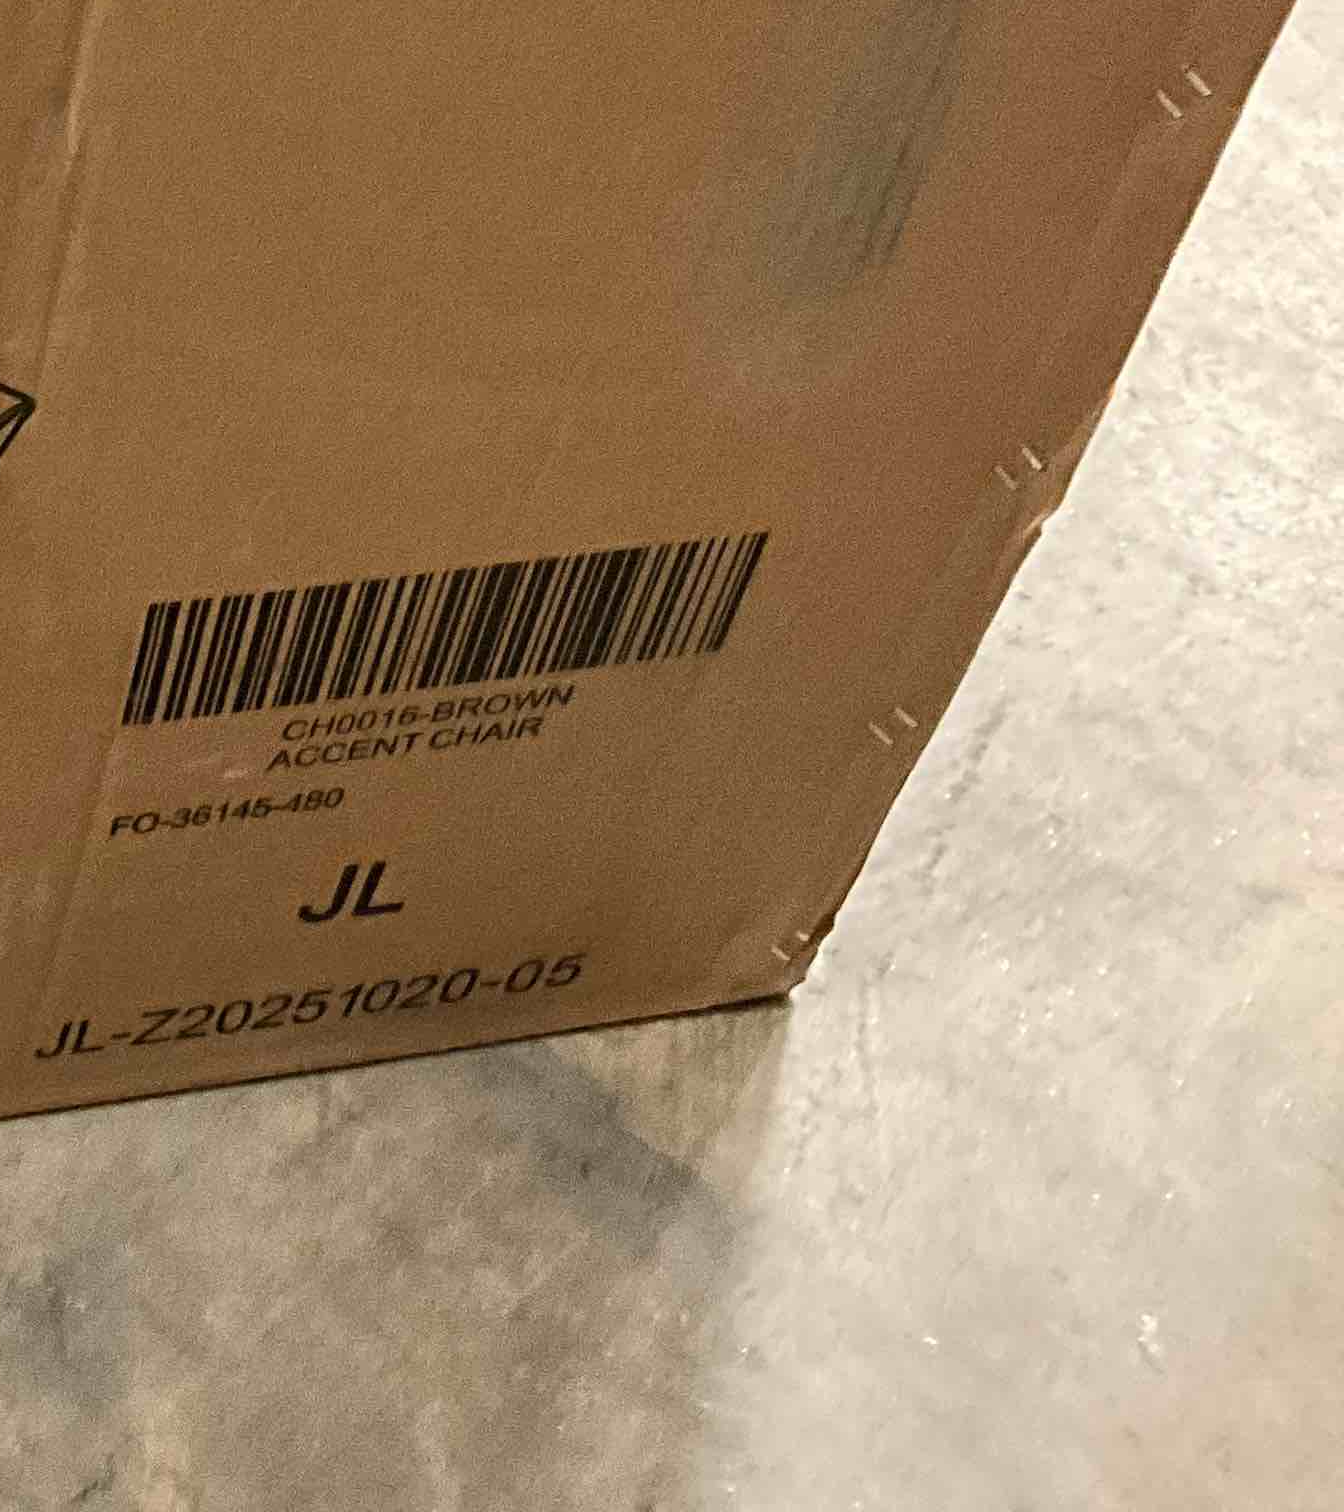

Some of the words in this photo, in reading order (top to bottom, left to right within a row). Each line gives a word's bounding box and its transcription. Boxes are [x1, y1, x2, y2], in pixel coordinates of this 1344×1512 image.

[281, 685, 576, 742] CH0016-BROWN
[265, 731, 423, 772] ACCENT
[428, 716, 545, 751] CHAIR
[109, 787, 345, 837] FO-36145-480
[297, 859, 405, 923] JL
[33, 952, 588, 1059] JL-Z20251020-05
